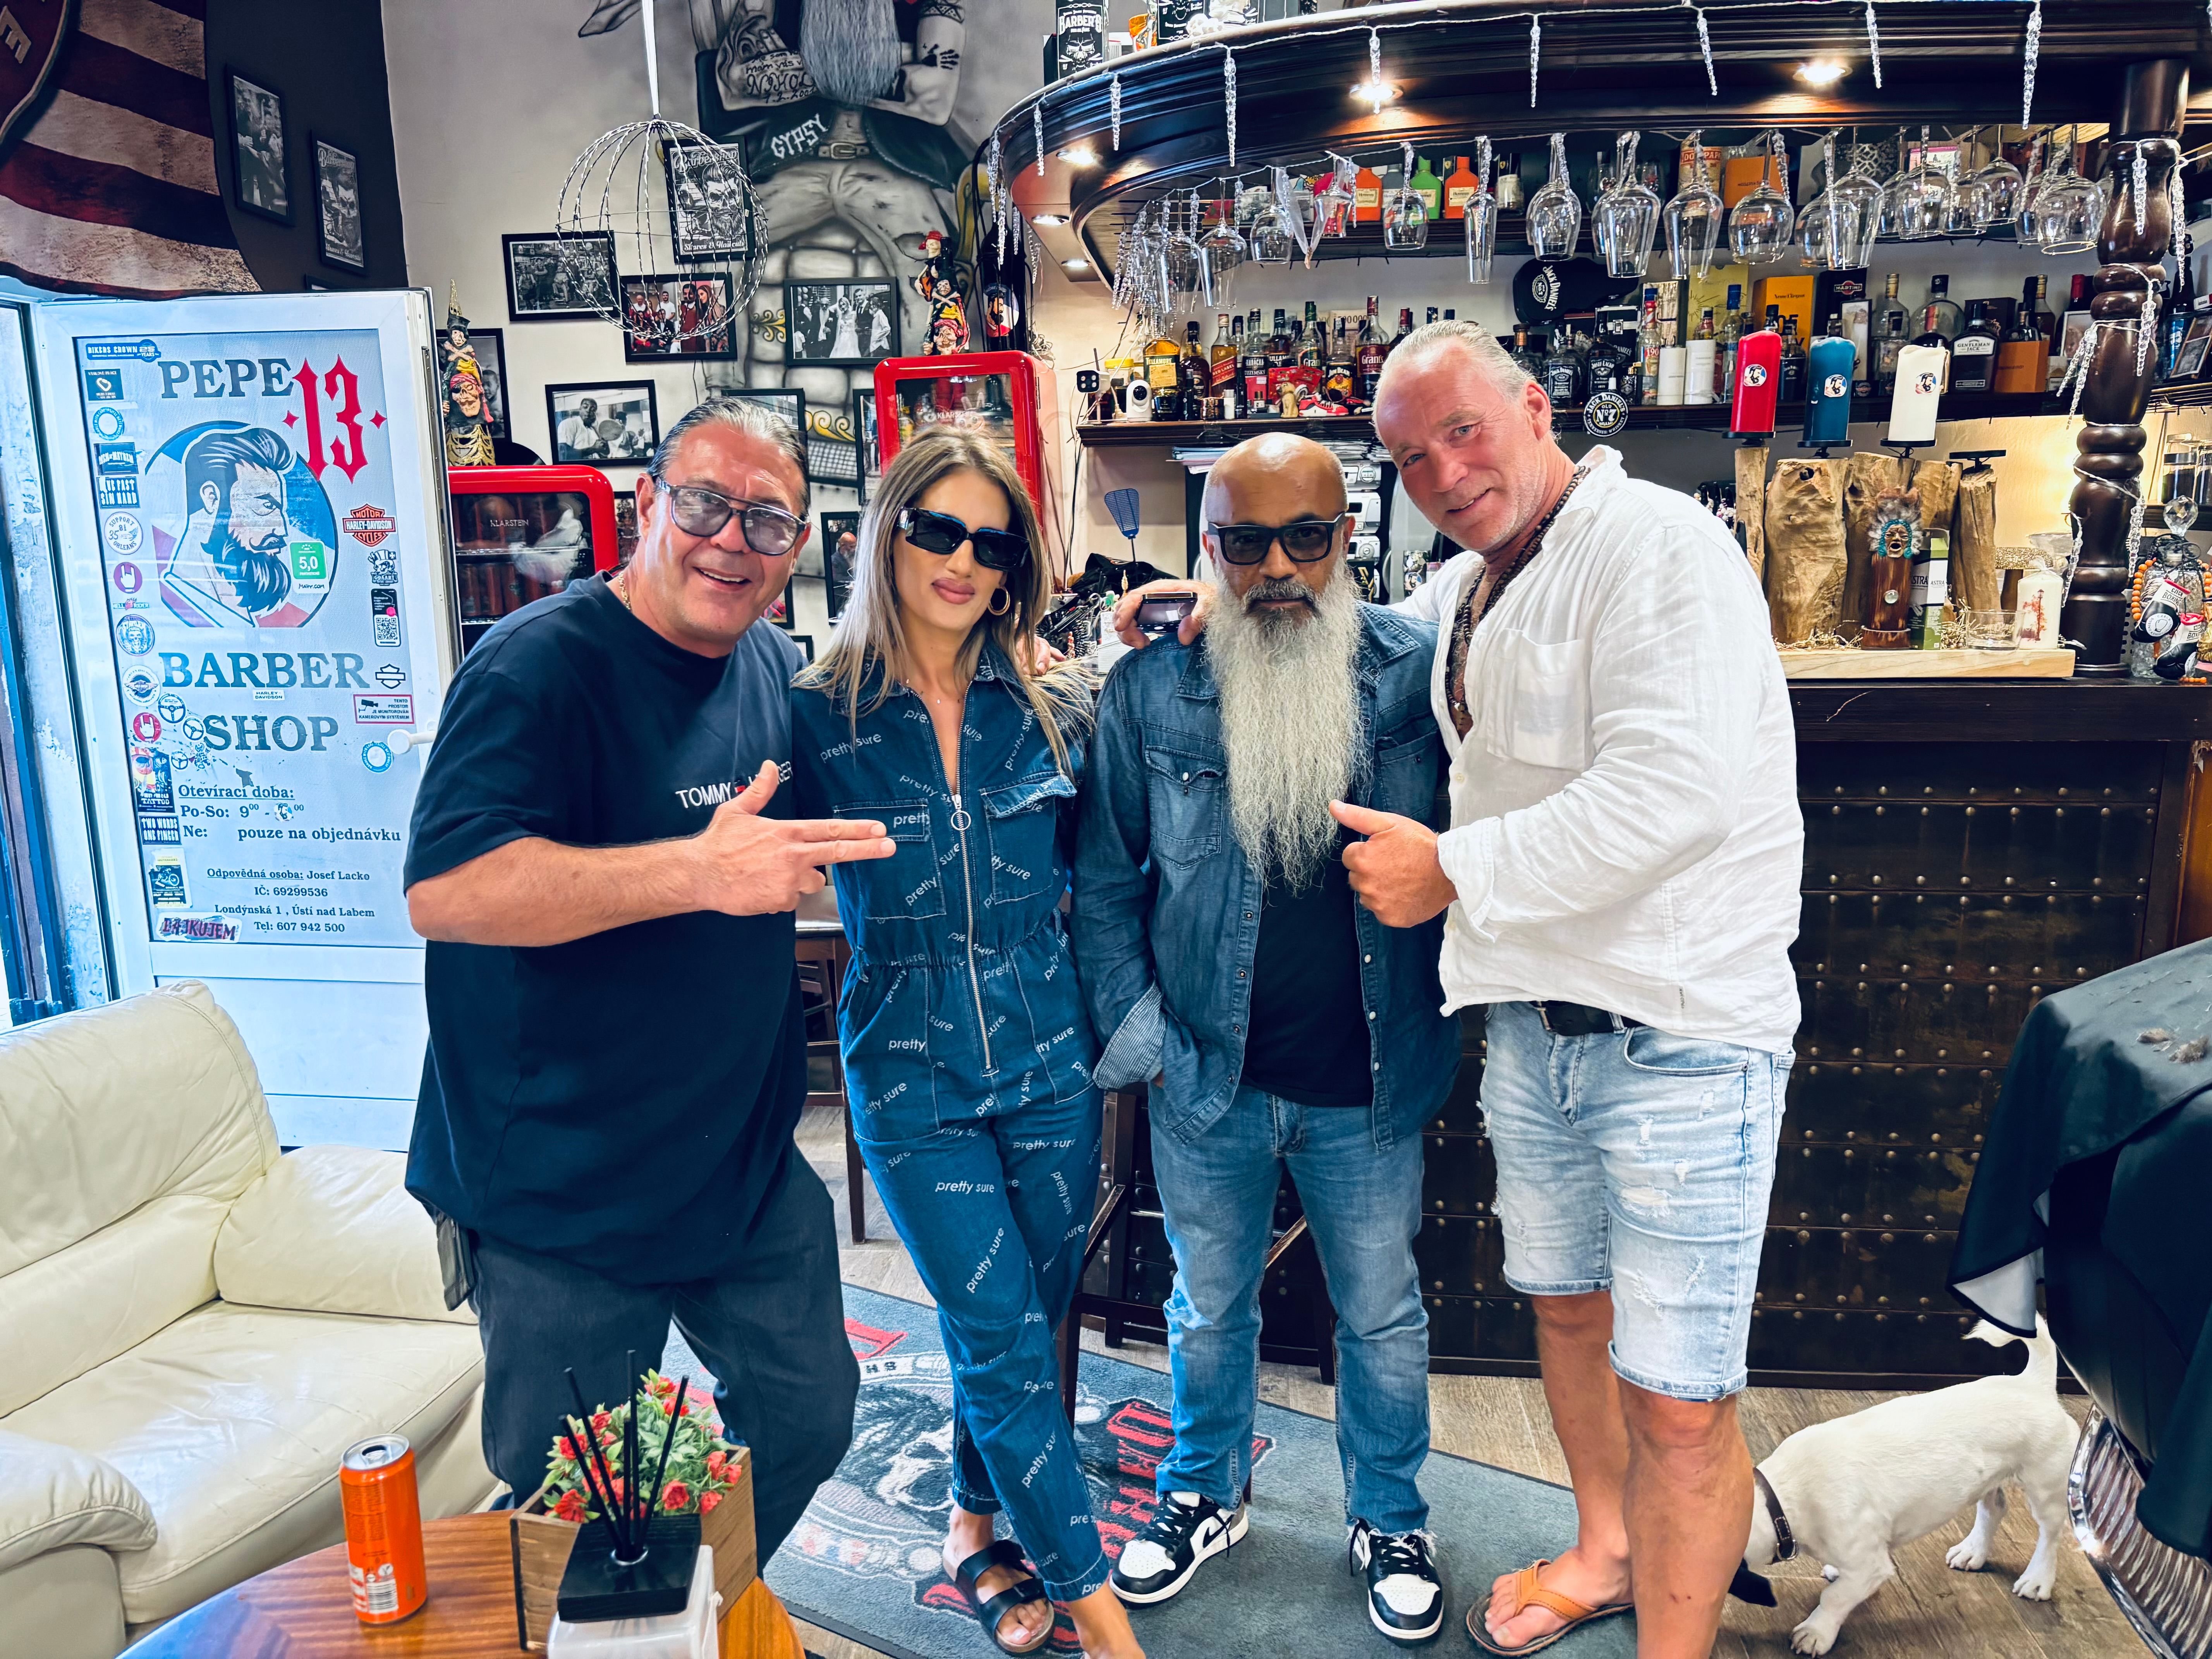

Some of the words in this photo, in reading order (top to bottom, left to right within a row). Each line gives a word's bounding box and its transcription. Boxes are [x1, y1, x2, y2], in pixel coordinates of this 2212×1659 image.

[771, 113, 828, 159] GYPSY
[158, 358, 294, 398] PEPE
[1587, 397, 1601, 413] JACK
[1602, 393, 1626, 411] DANIEL'S
[292, 354, 368, 484] 13
[356, 508, 381, 518] MOTOR
[109, 516, 135, 527] SUPPORT
[346, 520, 393, 531] HARLEY-DAVIDSON
[490, 519, 529, 527] KLARSTEIN
[112, 540, 137, 550] ORLEANS
[357, 532, 383, 544] CYCLES
[299, 556, 319, 571] 5,0
[158, 652, 370, 689] BARBER
[203, 715, 339, 751] SHOP
[856, 733, 882, 747] sure
[252, 785, 294, 798] doba:
[675, 782, 732, 809] TOMMY
[180, 805, 230, 818] Po-So:
[183, 825, 208, 838] Ne:
[238, 828, 283, 842] pouze
[289, 830, 307, 840] na
[312, 827, 401, 843] objednávku
[939, 843, 960, 866] sure
[207, 868, 266, 879] Odpovědná
[270, 869, 304, 879] osoba:
[307, 871, 336, 880] Josef
[338, 871, 370, 881] Lacko
[1006, 862, 1031, 880] sure
[254, 884, 270, 896] IČ:
[273, 887, 328, 897] 69299536
[905, 876, 938, 907] pretty
[215, 904, 272, 916] Londýnská
[276, 906, 282, 914] 1
[292, 903, 313, 915] Ústí
[316, 906, 336, 917] nad
[339, 907, 375, 917] Labem
[254, 921, 273, 931] Tel:
[276, 922, 297, 931] 607
[301, 922, 321, 932] 942
[325, 923, 345, 933] 500
[929, 1014, 953, 1032] sure
[1052, 1026, 1075, 1044] sure
[888, 1039, 926, 1052] pretty
[883, 1082, 908, 1103] sure
[1013, 1140, 1049, 1150] pretty
[935, 1180, 974, 1194] pretty
[975, 1182, 995, 1193] sure
[1051, 1171, 1068, 1197] pretty
[966, 1255, 993, 1294] pretty
[989, 1227, 1005, 1255] sure
[1021, 1449, 1049, 1488] pretty
